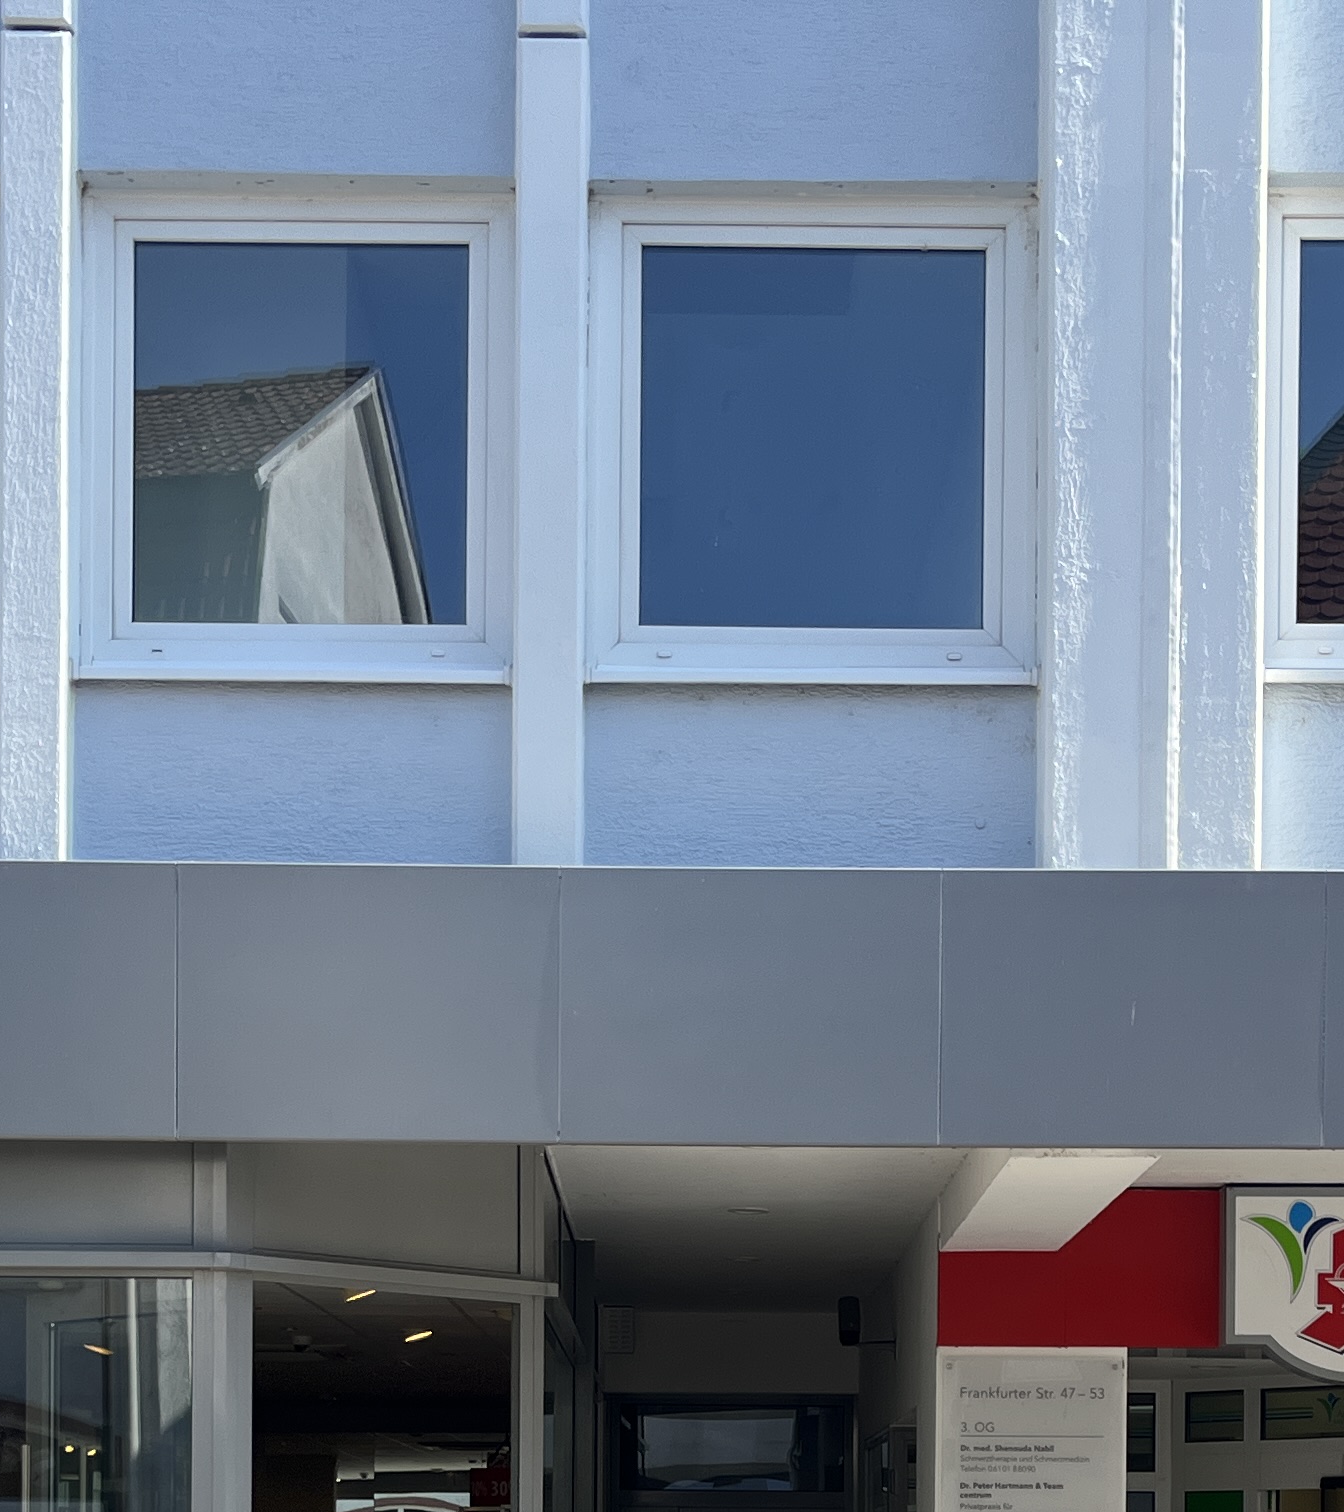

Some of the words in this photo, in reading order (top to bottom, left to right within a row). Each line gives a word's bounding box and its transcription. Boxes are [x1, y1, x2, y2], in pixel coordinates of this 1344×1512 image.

[960, 1387, 1031, 1399] Frankfurter
[1036, 1387, 1055, 1399] Str.
[1060, 1388, 1075, 1399] 47
[1089, 1388, 1105, 1399] 53
[961, 1422, 970, 1432] 3.
[974, 1422, 995, 1432] OG
